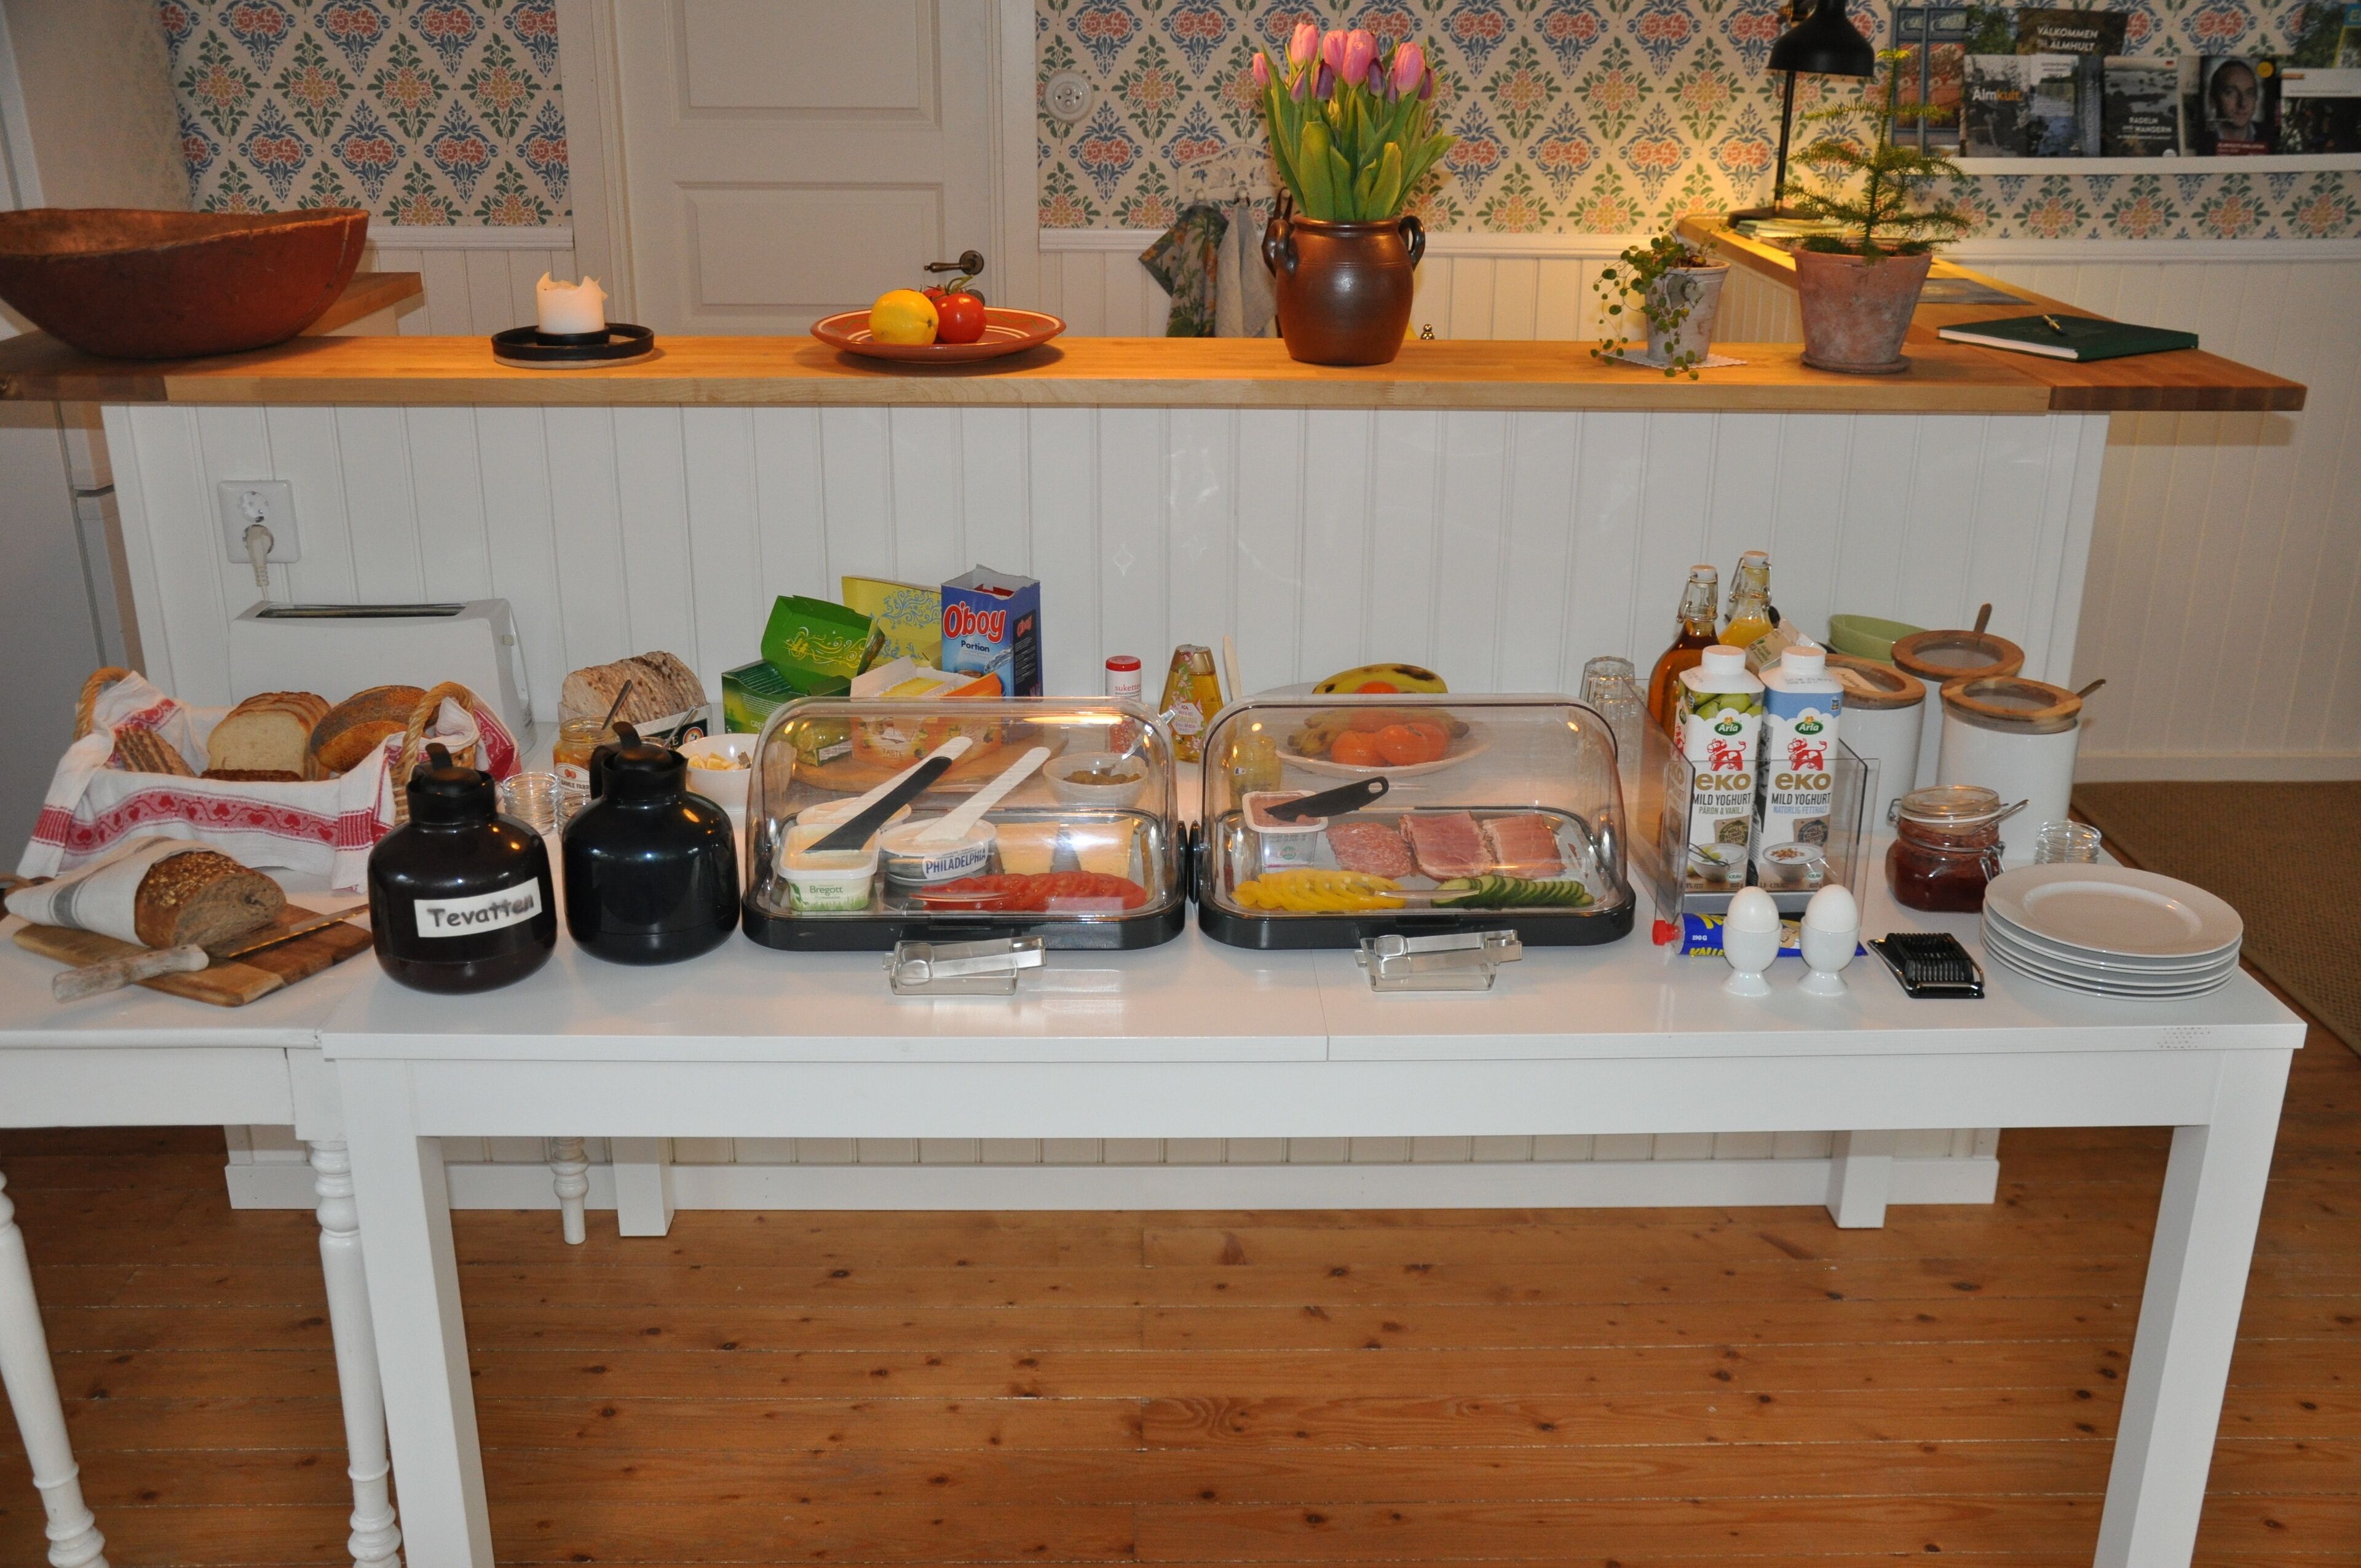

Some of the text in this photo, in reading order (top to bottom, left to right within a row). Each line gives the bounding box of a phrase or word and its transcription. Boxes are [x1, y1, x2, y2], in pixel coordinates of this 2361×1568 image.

[2036, 26, 2098, 39] VÄLKOMMEN
[2049, 39, 2095, 51] ÄLMHULT
[943, 601, 1006, 643] O'boy
[961, 640, 990, 652] Portion
[1115, 683, 1141, 692] sukette
[1717, 724, 1738, 732] Arla
[1798, 723, 1819, 732] Arla
[882, 748, 903, 758] TASTE
[1693, 794, 1713, 805] MILD
[1715, 793, 1752, 806] YOGHURT
[1771, 792, 1831, 805] MILD YOGHURT
[1699, 806, 1718, 814] PÄRON
[1773, 806, 1827, 814] NATURLIG FETTHALT
[925, 849, 986, 874] PHILADELPHIA
[810, 885, 844, 896] Bregott
[427, 893, 535, 927] Tevatten
